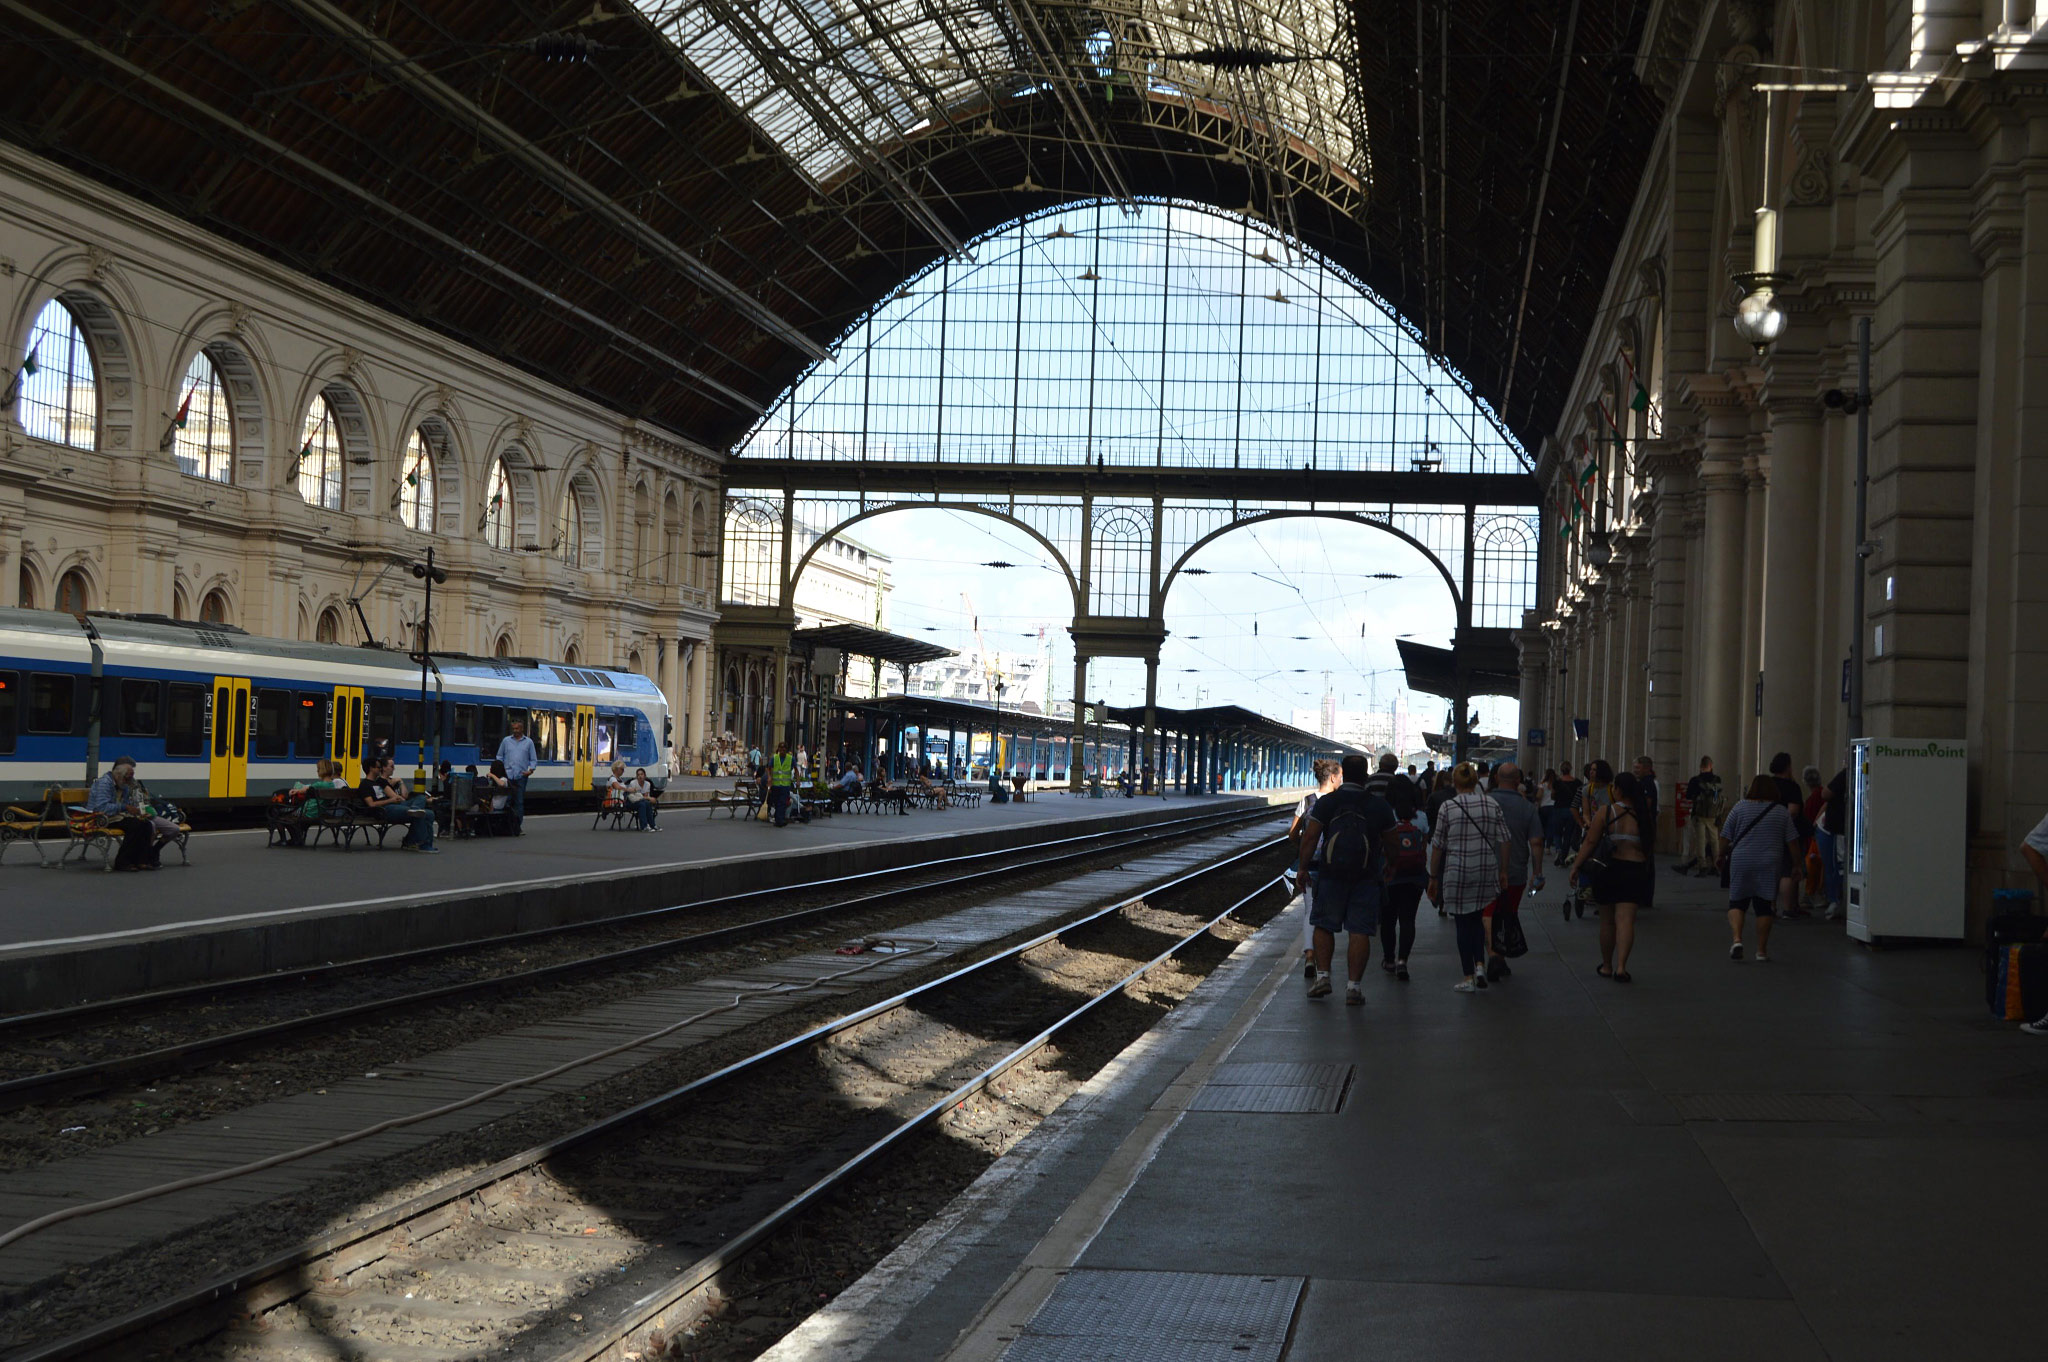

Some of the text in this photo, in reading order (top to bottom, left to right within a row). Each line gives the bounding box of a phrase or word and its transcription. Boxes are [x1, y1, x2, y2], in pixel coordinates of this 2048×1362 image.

[206, 695, 212, 708] 2
[251, 698, 257, 710] 2
[1875, 743, 1966, 758] PharmaPoint
